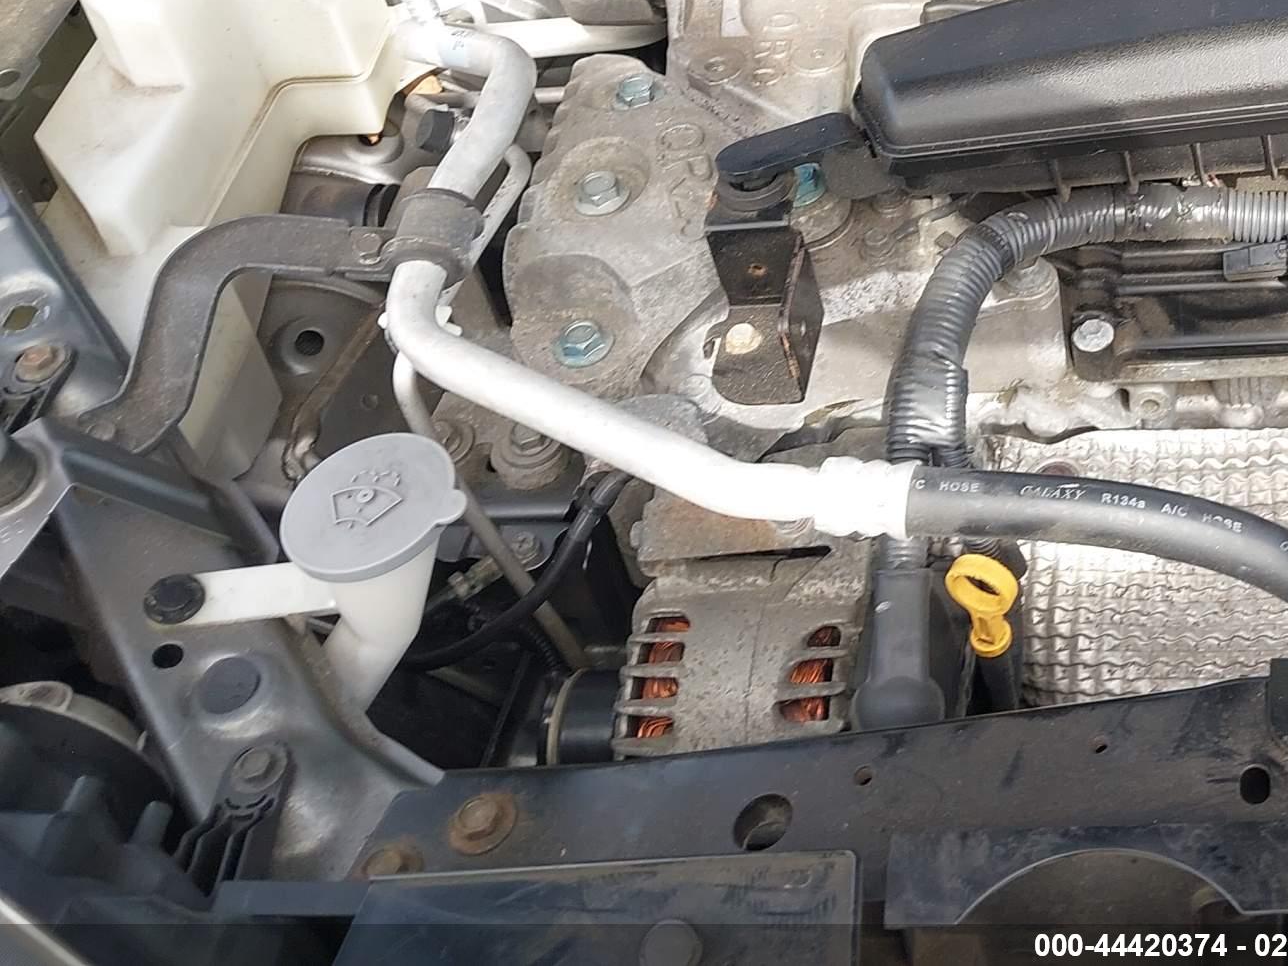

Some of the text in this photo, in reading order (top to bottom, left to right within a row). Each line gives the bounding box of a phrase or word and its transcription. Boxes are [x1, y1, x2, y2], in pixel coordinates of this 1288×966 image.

[939, 481, 980, 493] HOSE
[1101, 492, 1147, 510] R134a
[1161, 502, 1189, 518] A/C
